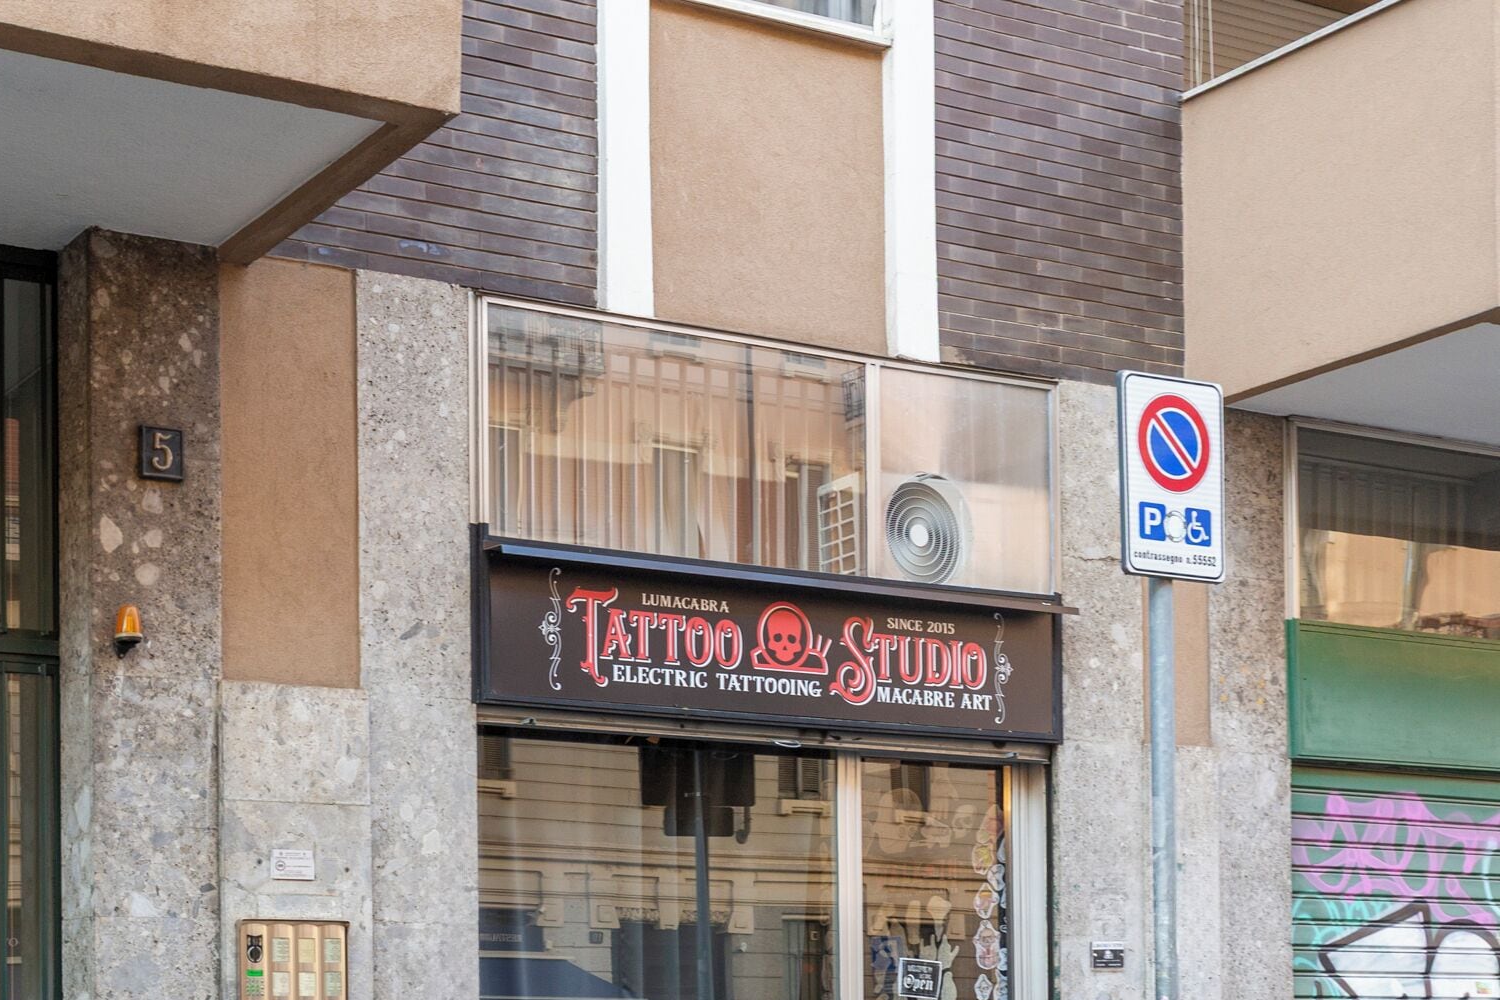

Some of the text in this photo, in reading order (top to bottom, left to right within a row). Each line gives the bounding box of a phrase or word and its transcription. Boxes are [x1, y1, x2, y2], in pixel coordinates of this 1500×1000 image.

[152, 432, 173, 470] 5
[1144, 506, 1162, 535] P
[1134, 549, 1182, 564] contrassegno
[641, 592, 730, 613] LUMACABRA
[887, 617, 956, 635] SINCE 2015
[611, 664, 823, 698] ELECTRIC TATTOOING
[877, 686, 993, 711] MACABRE ART
[903, 974, 934, 991] Open
